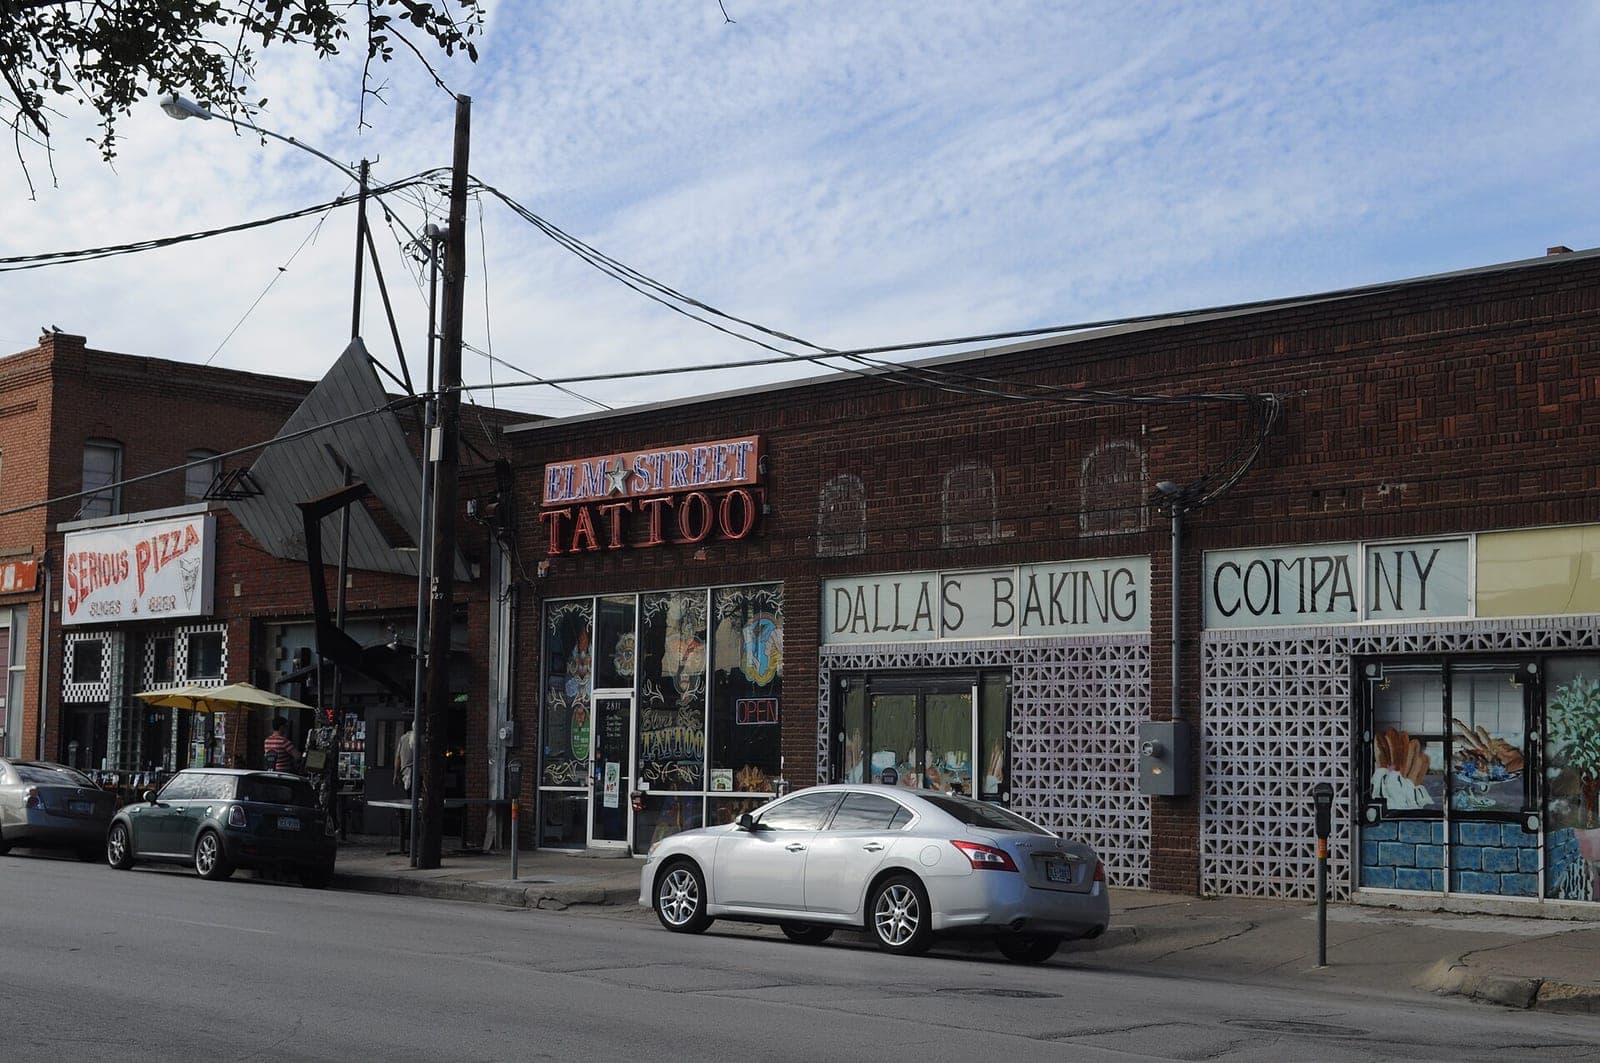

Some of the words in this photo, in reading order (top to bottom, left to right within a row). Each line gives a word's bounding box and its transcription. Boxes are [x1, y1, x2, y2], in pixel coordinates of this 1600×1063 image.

[547, 462, 608, 503] ELM
[631, 440, 754, 494] STREET
[539, 489, 756, 555] TATTOO
[67, 550, 129, 616] SERIOUS
[135, 524, 200, 598] PIZZA
[832, 580, 964, 635] DALLAS
[992, 567, 1137, 628] BAKING
[1213, 548, 1440, 618] COMPANY
[89, 600, 122, 616] SLICES
[149, 595, 177, 612] BEER
[640, 727, 705, 761] TATTOO
[738, 701, 777, 723] OPEN
